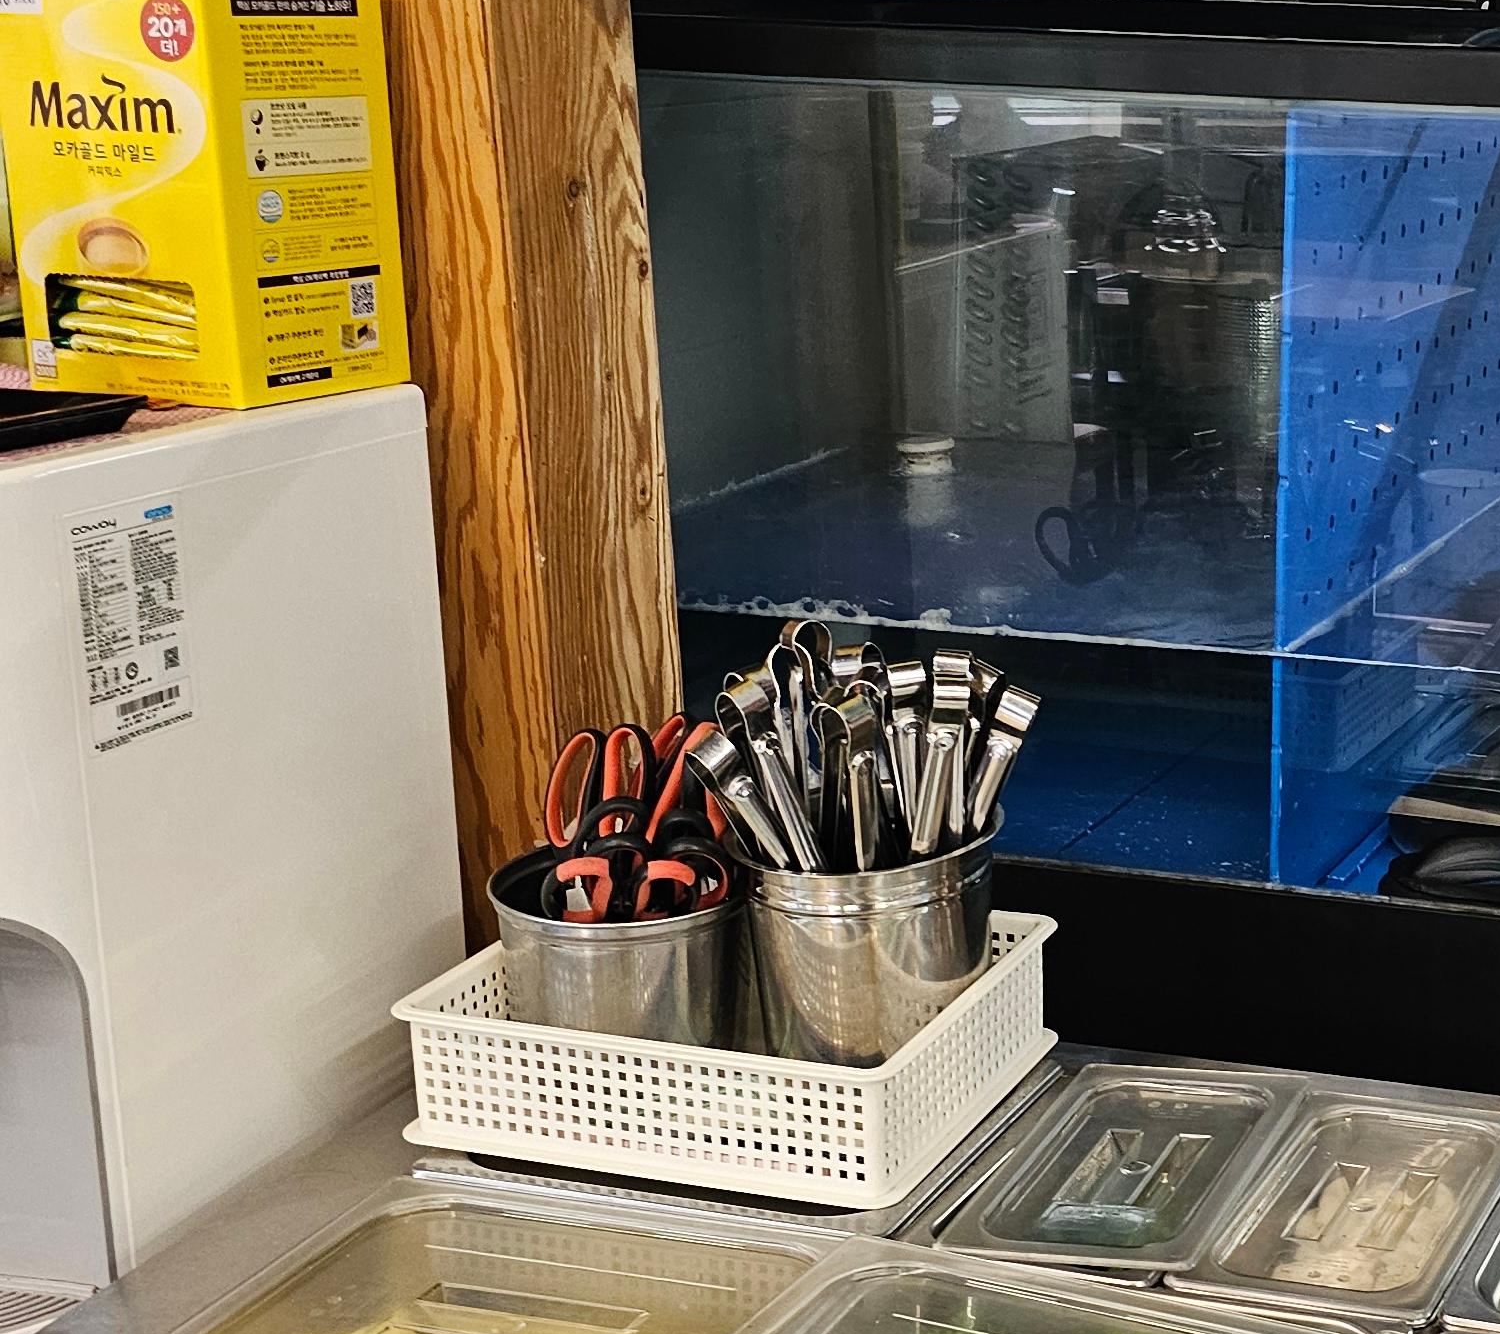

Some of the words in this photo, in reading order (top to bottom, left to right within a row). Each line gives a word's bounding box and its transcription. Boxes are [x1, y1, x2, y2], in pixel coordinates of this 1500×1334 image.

[147, 16, 187, 37] 20개
[30, 73, 175, 134] Maxim
[53, 141, 107, 160] 모카골드
[113, 144, 156, 163] 마일드
